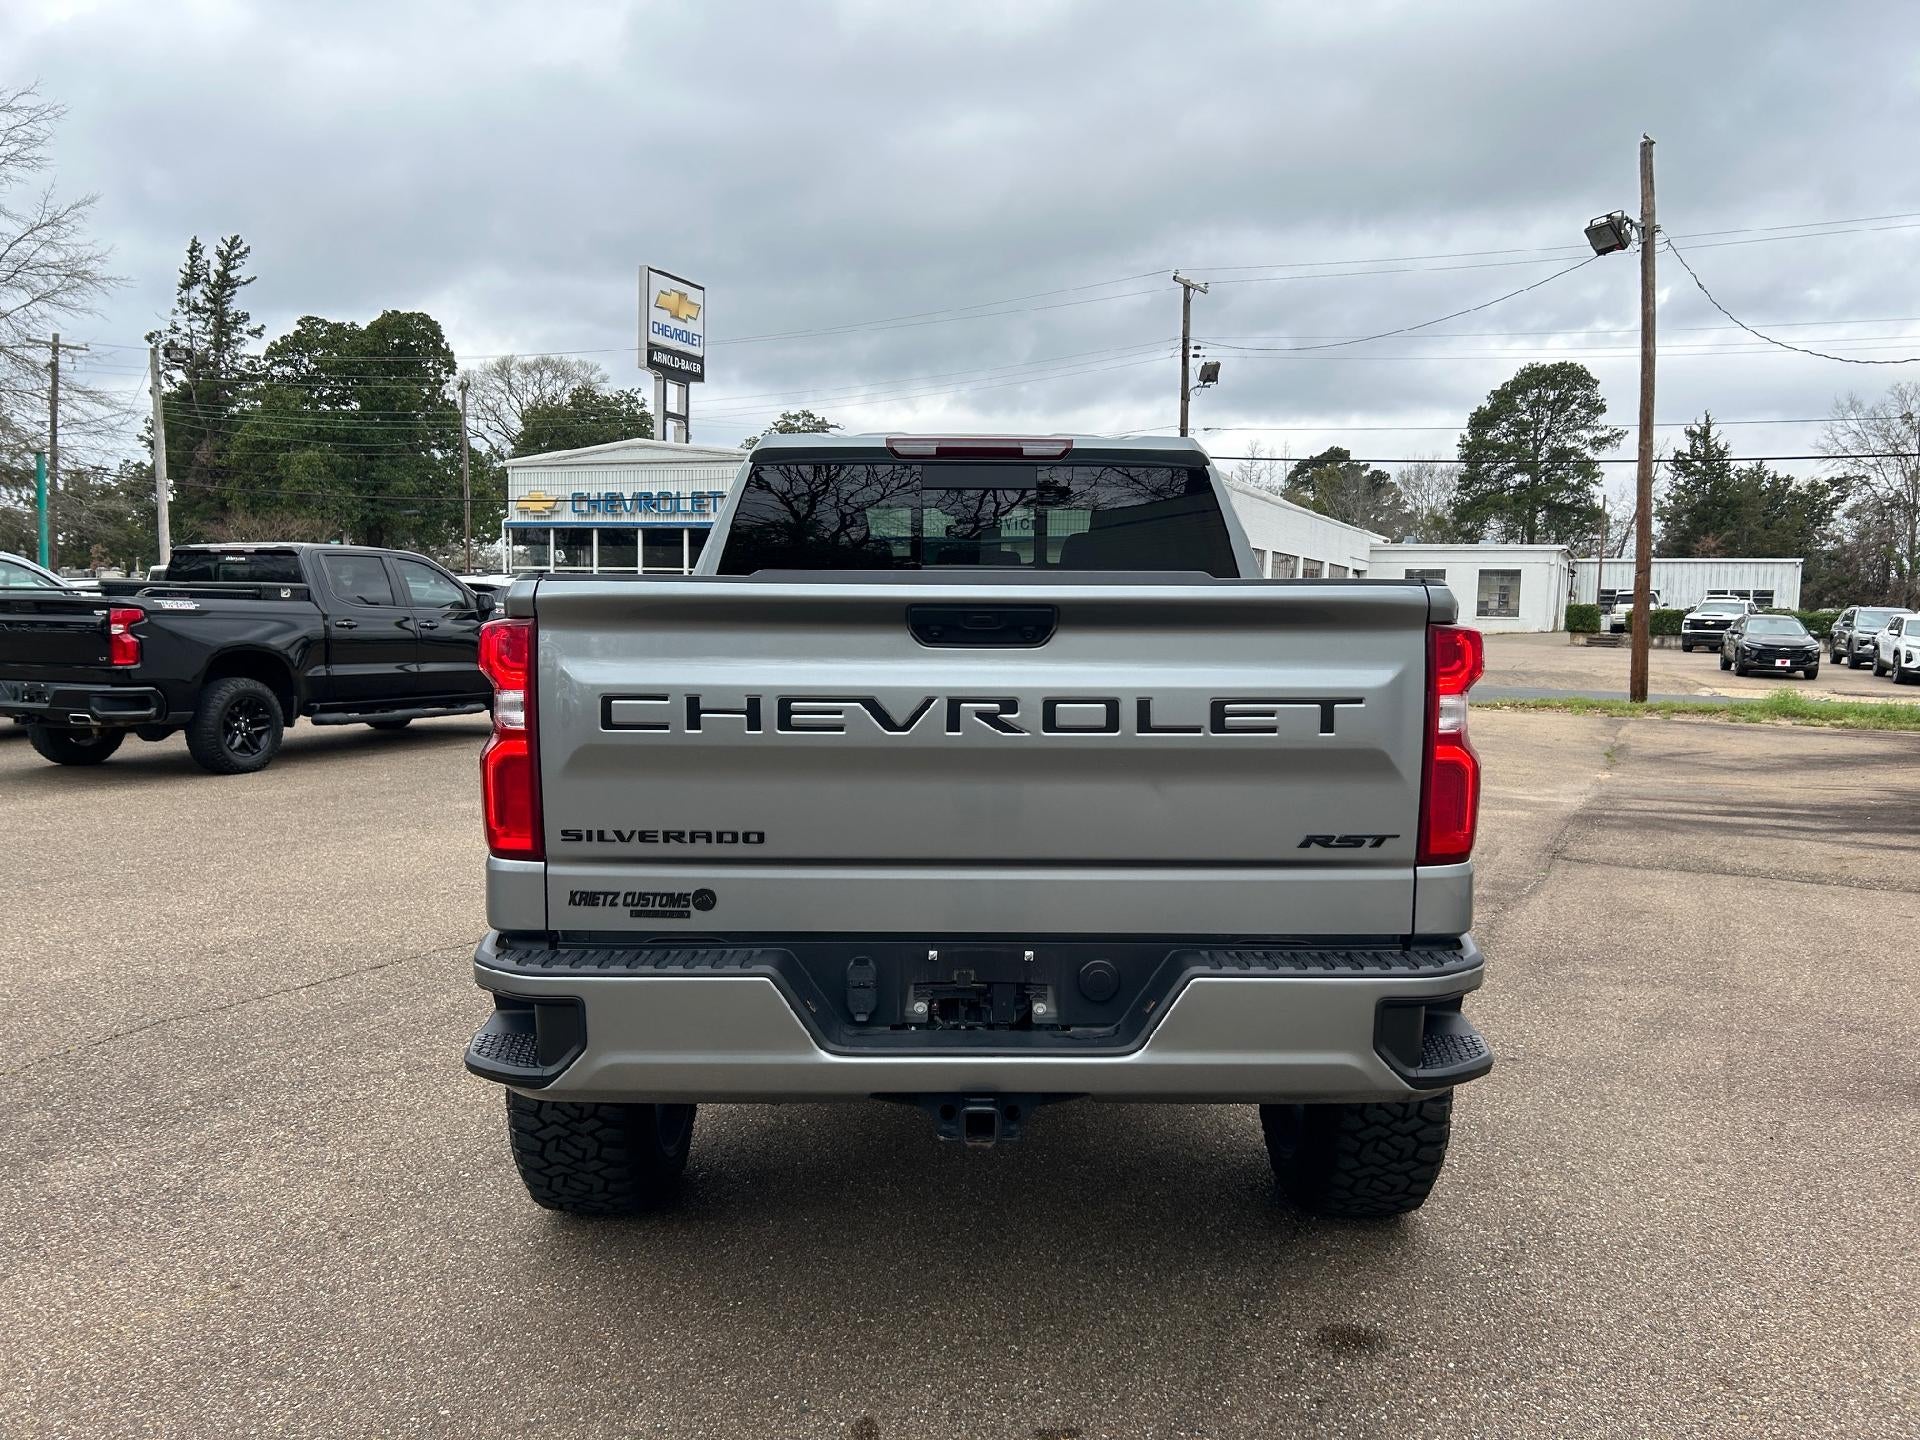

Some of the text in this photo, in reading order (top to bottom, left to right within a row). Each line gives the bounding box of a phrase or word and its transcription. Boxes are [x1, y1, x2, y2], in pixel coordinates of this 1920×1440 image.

[652, 320, 702, 348] CHEVROLET
[652, 350, 701, 374] ARNOLD-BAKER
[571, 490, 726, 513] CHEVROLET
[599, 693, 1366, 737] CHEVROLET
[560, 829, 766, 845] SILVERADO
[1297, 834, 1401, 849] RST
[568, 889, 692, 909] KRIETZ CUSTOMS
